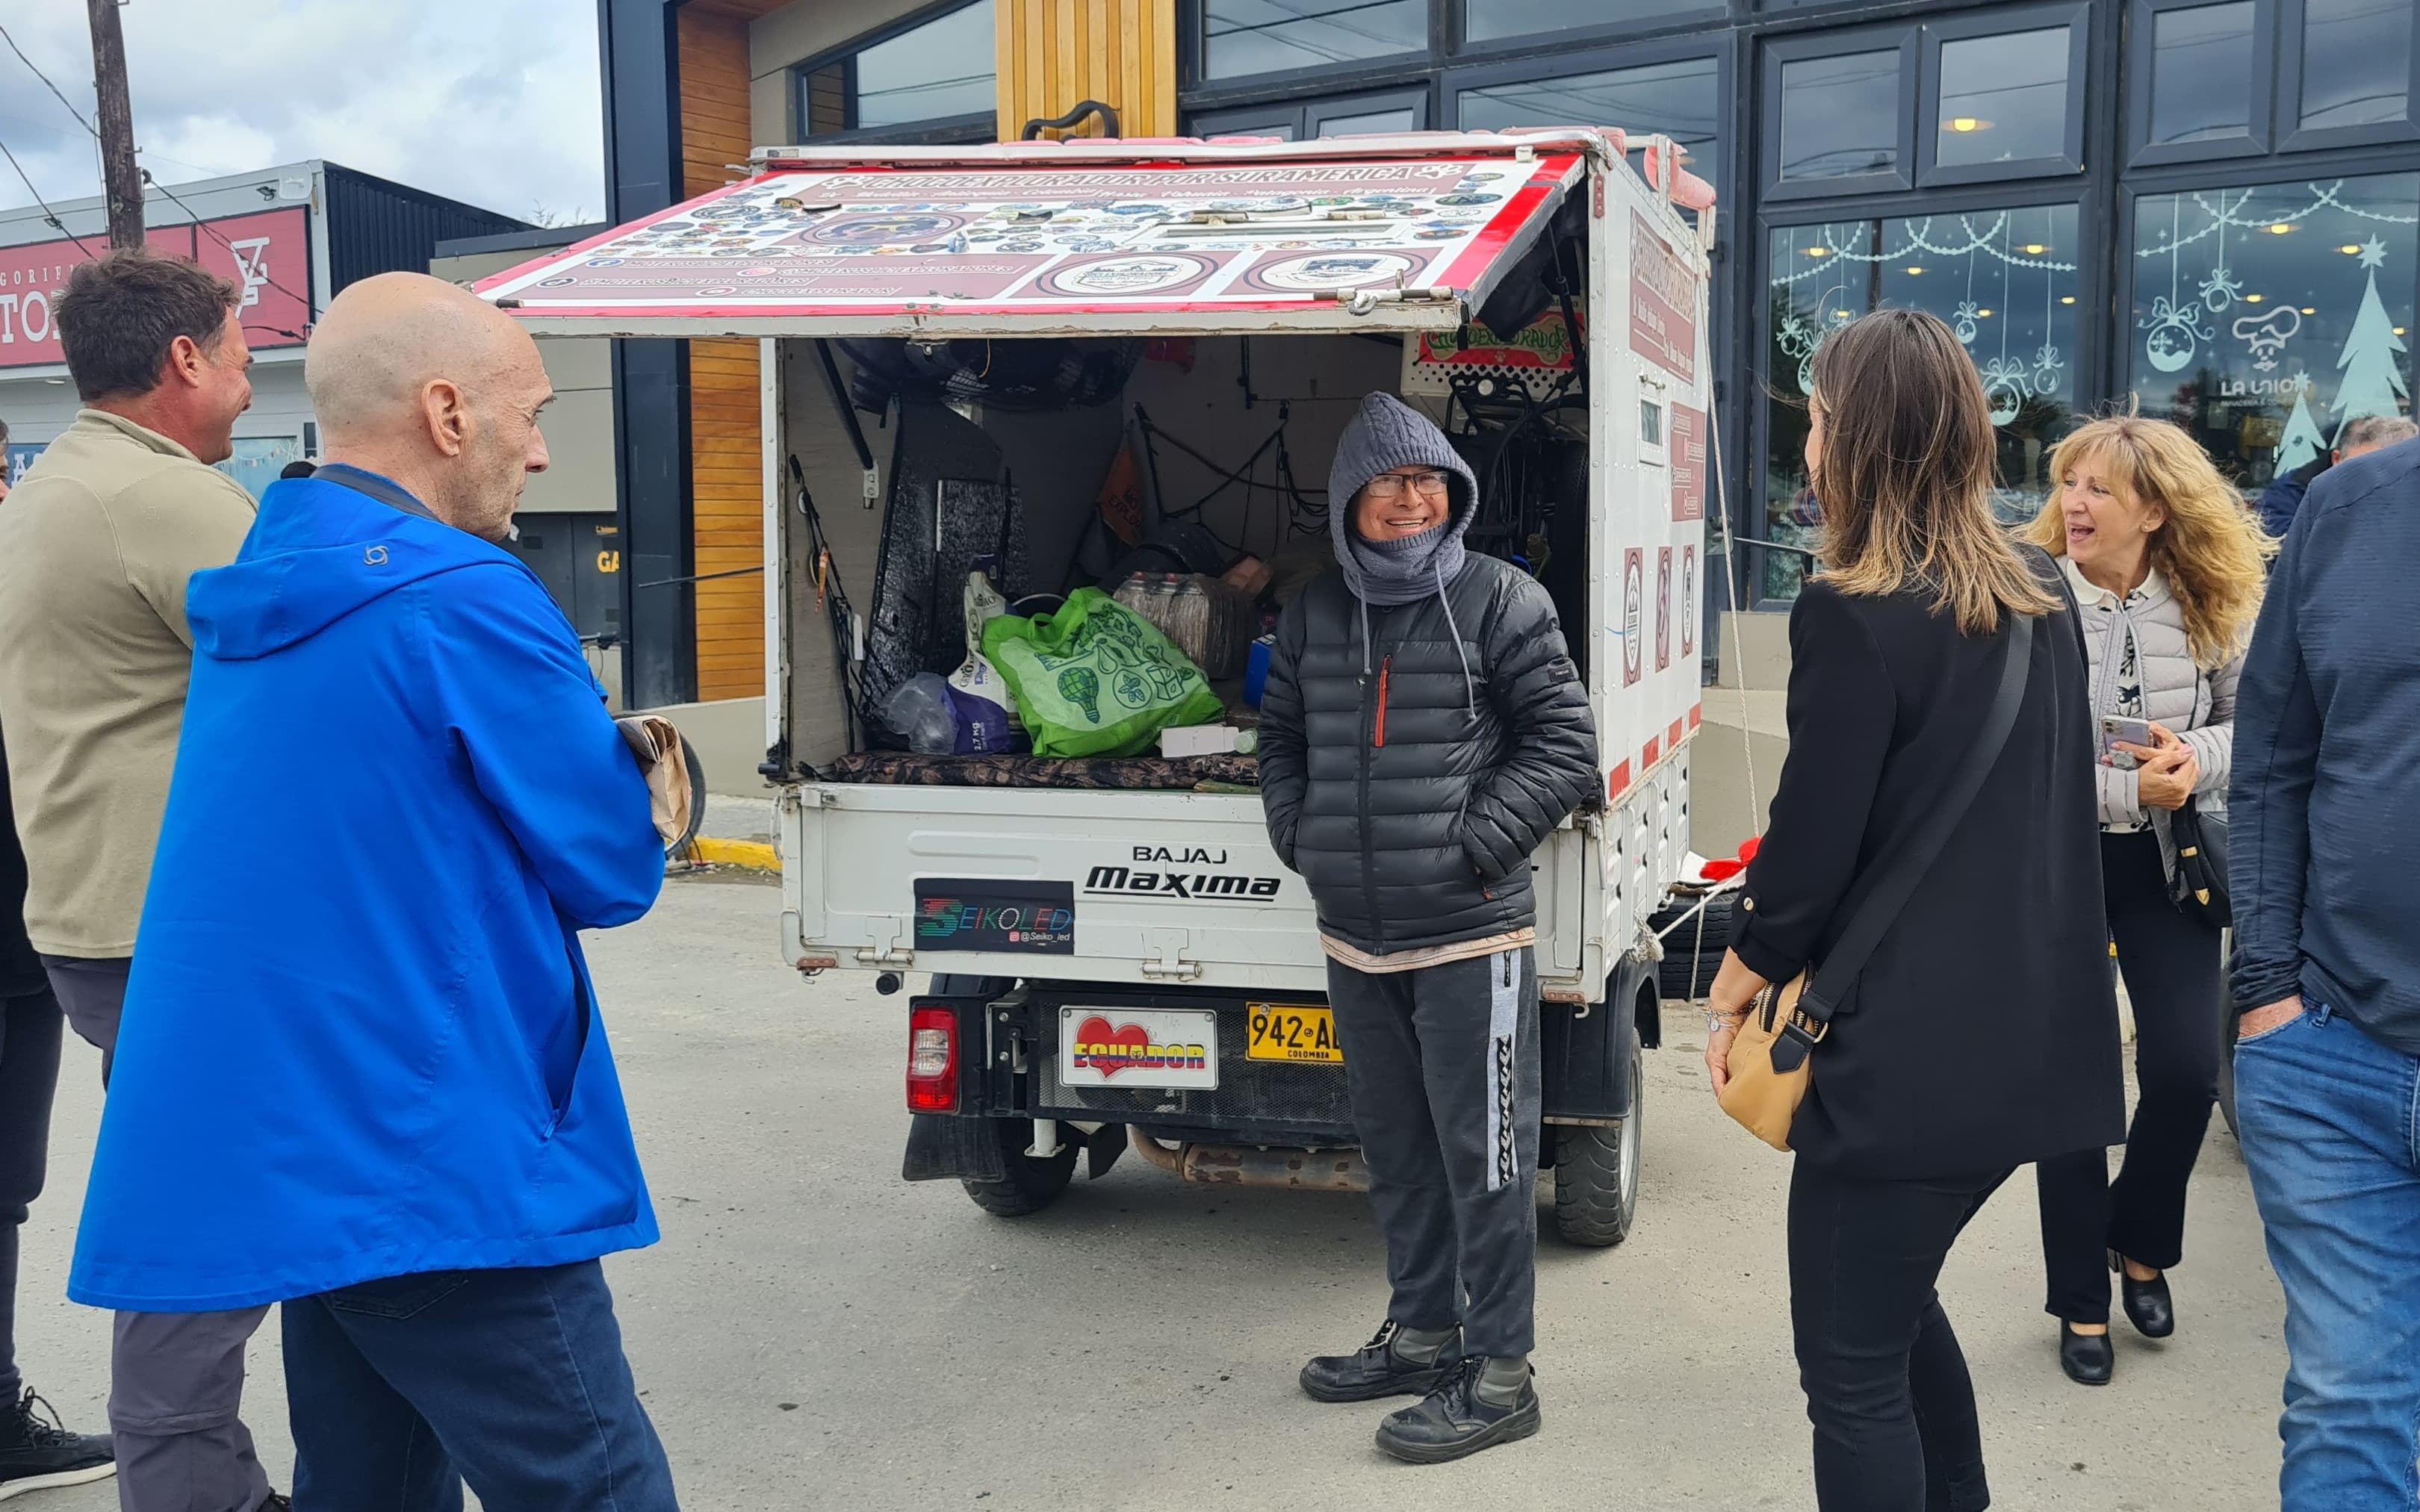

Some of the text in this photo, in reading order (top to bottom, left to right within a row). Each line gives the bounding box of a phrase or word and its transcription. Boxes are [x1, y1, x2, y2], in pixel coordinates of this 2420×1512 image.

[863, 167, 1414, 189] CHOCOEXPLORADOR POR SURAMERICA
[2221, 381, 2246, 396] LA
[1133, 846, 1227, 864] BAJAJ
[918, 898, 1072, 936] SEIKOLED
[1020, 931, 1070, 943] @Seiko_led
[1252, 1014, 1303, 1048] 942
[1074, 1042, 1206, 1070] ECUADOR
[1287, 1049, 1330, 1059] COLOMBIA
